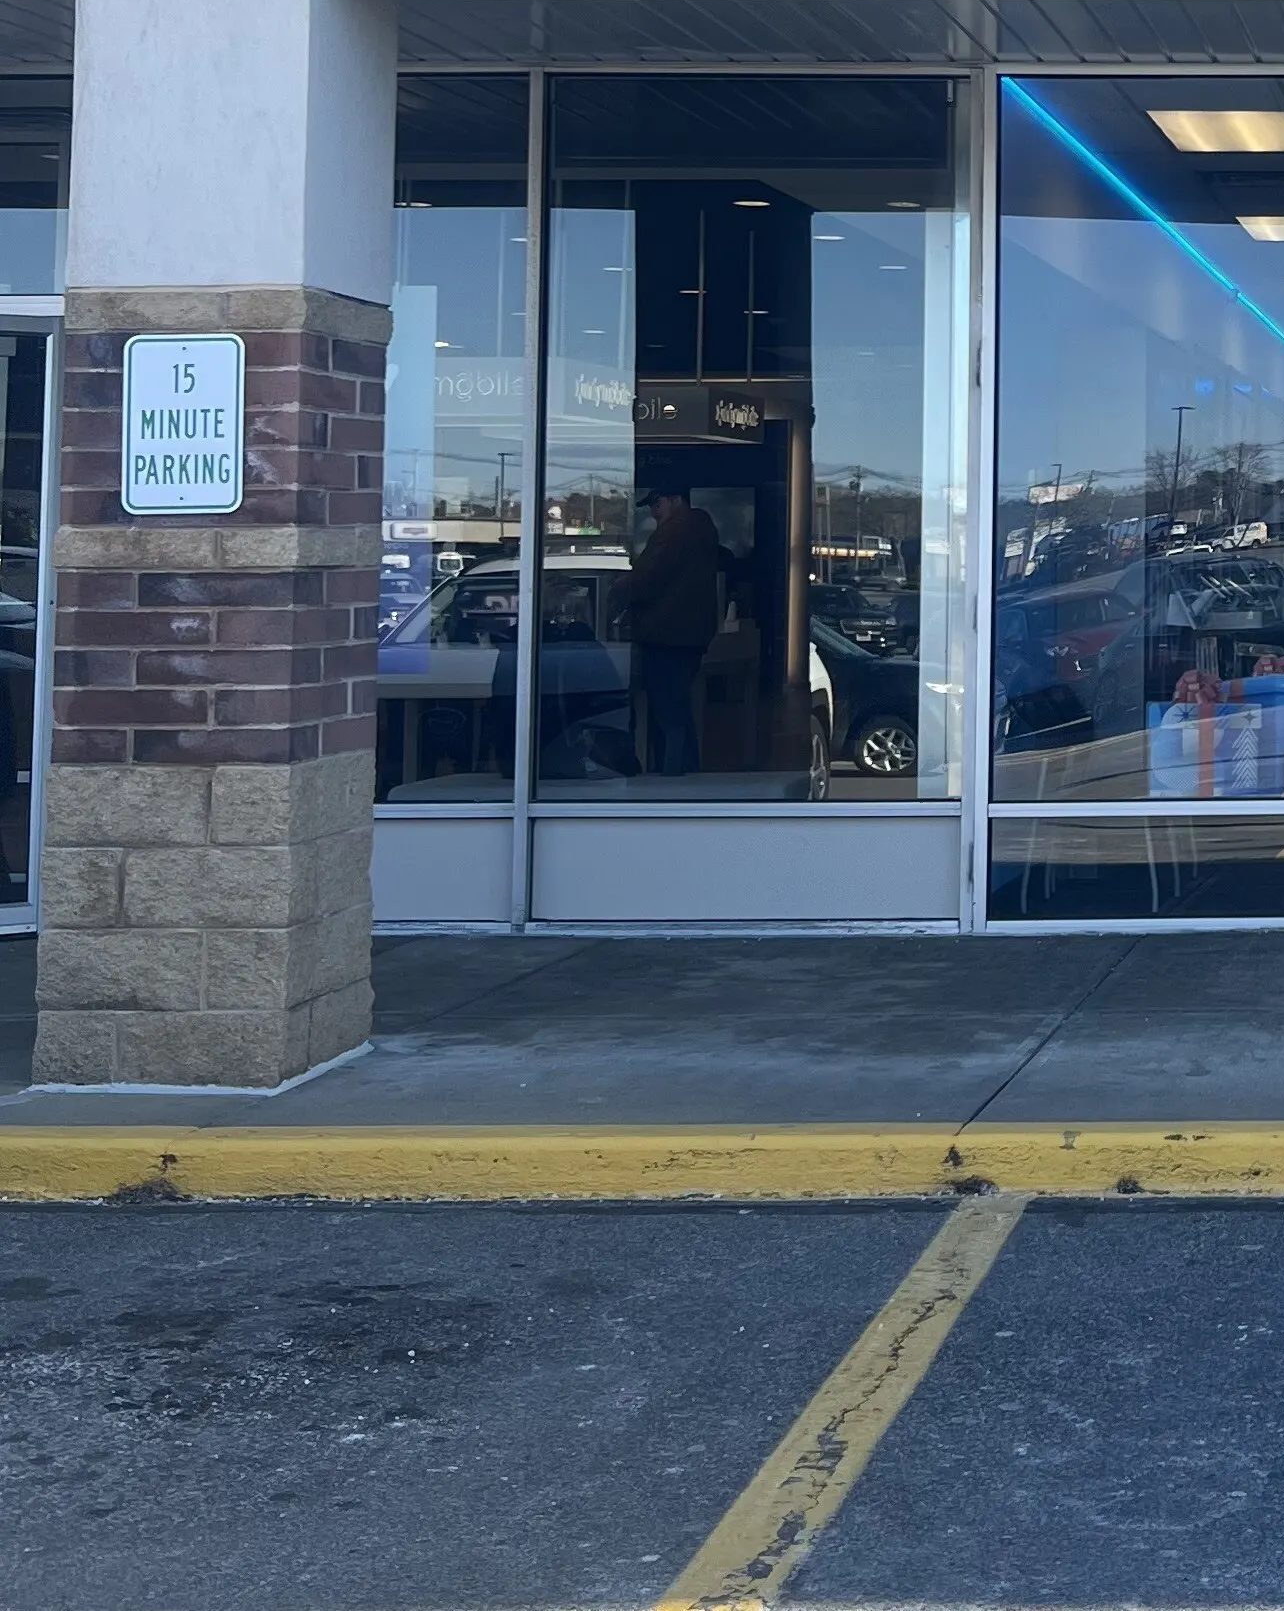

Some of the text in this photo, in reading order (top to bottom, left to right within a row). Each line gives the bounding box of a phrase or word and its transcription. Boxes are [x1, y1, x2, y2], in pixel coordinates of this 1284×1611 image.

[172, 363, 196, 394] 15
[141, 408, 225, 440] MINUTE
[134, 454, 231, 485] PARKING
